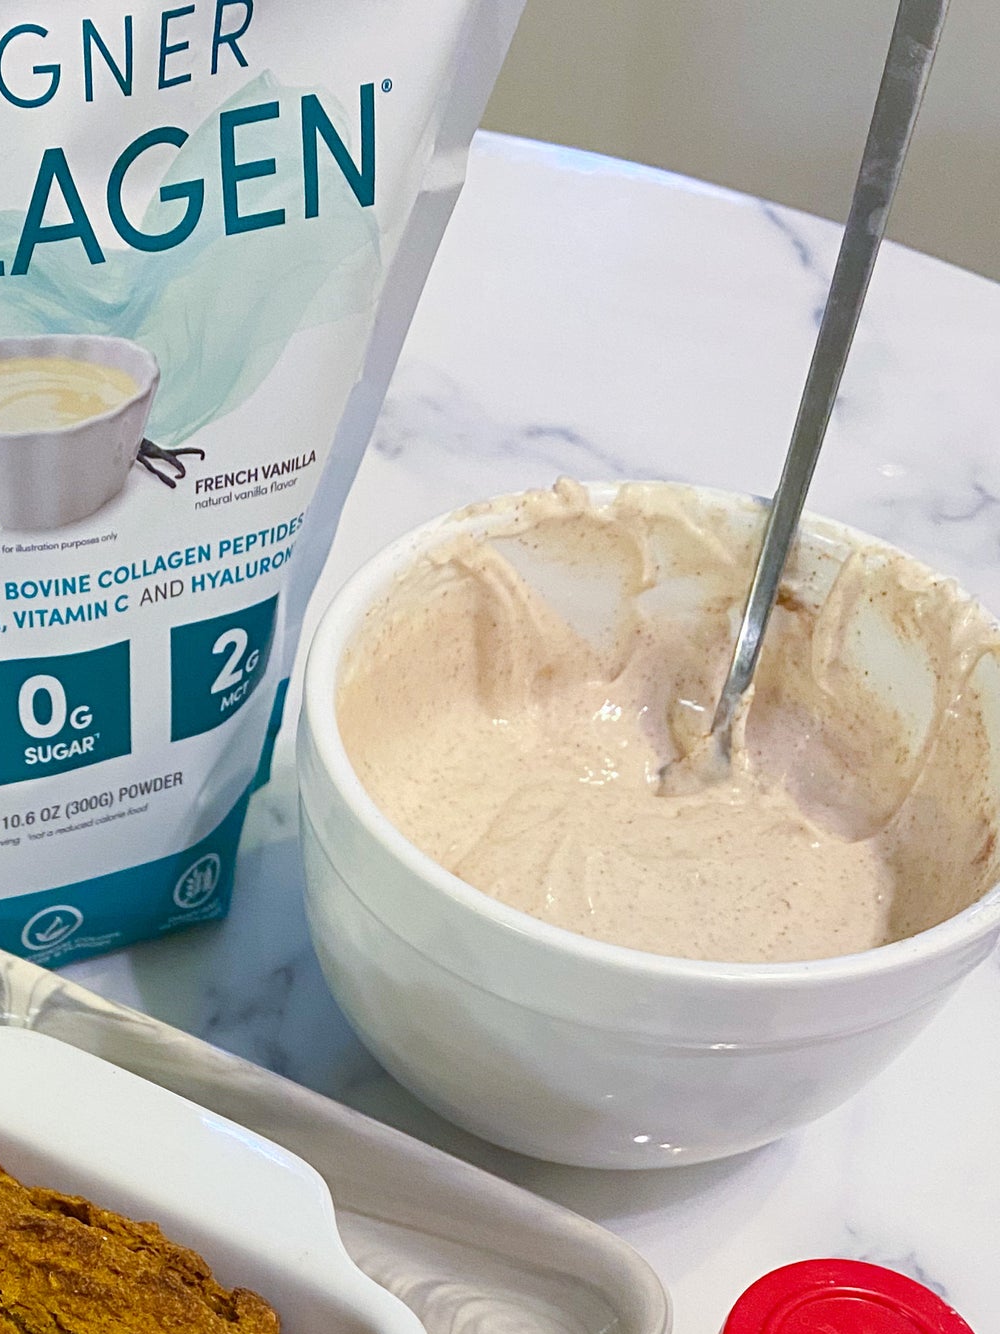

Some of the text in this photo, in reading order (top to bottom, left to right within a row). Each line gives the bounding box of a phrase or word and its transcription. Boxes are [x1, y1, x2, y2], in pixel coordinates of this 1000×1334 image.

[195, 450, 316, 494] FRENCH VANILLA
[195, 477, 298, 510] natural vanilla flavor
[2, 544, 13, 554] for
[15, 542, 59, 552] illustration
[61, 537, 99, 550] purposes
[101, 531, 117, 541] only
[4, 574, 90, 600] BOVINE
[97, 544, 211, 589] COLLAGEN
[219, 512, 304, 559] PEPTIDES
[13, 600, 108, 628] VITAMIN
[114, 595, 129, 612] C
[139, 579, 184, 606] AND
[220, 681, 250, 712] MCT
[24, 736, 95, 765] SUGAR
[2, 811, 36, 830] 10.6
[40, 804, 61, 822] OZ
[65, 792, 114, 820] (300G)
[118, 772, 183, 802] POWDER
[126, 803, 149, 816] food
